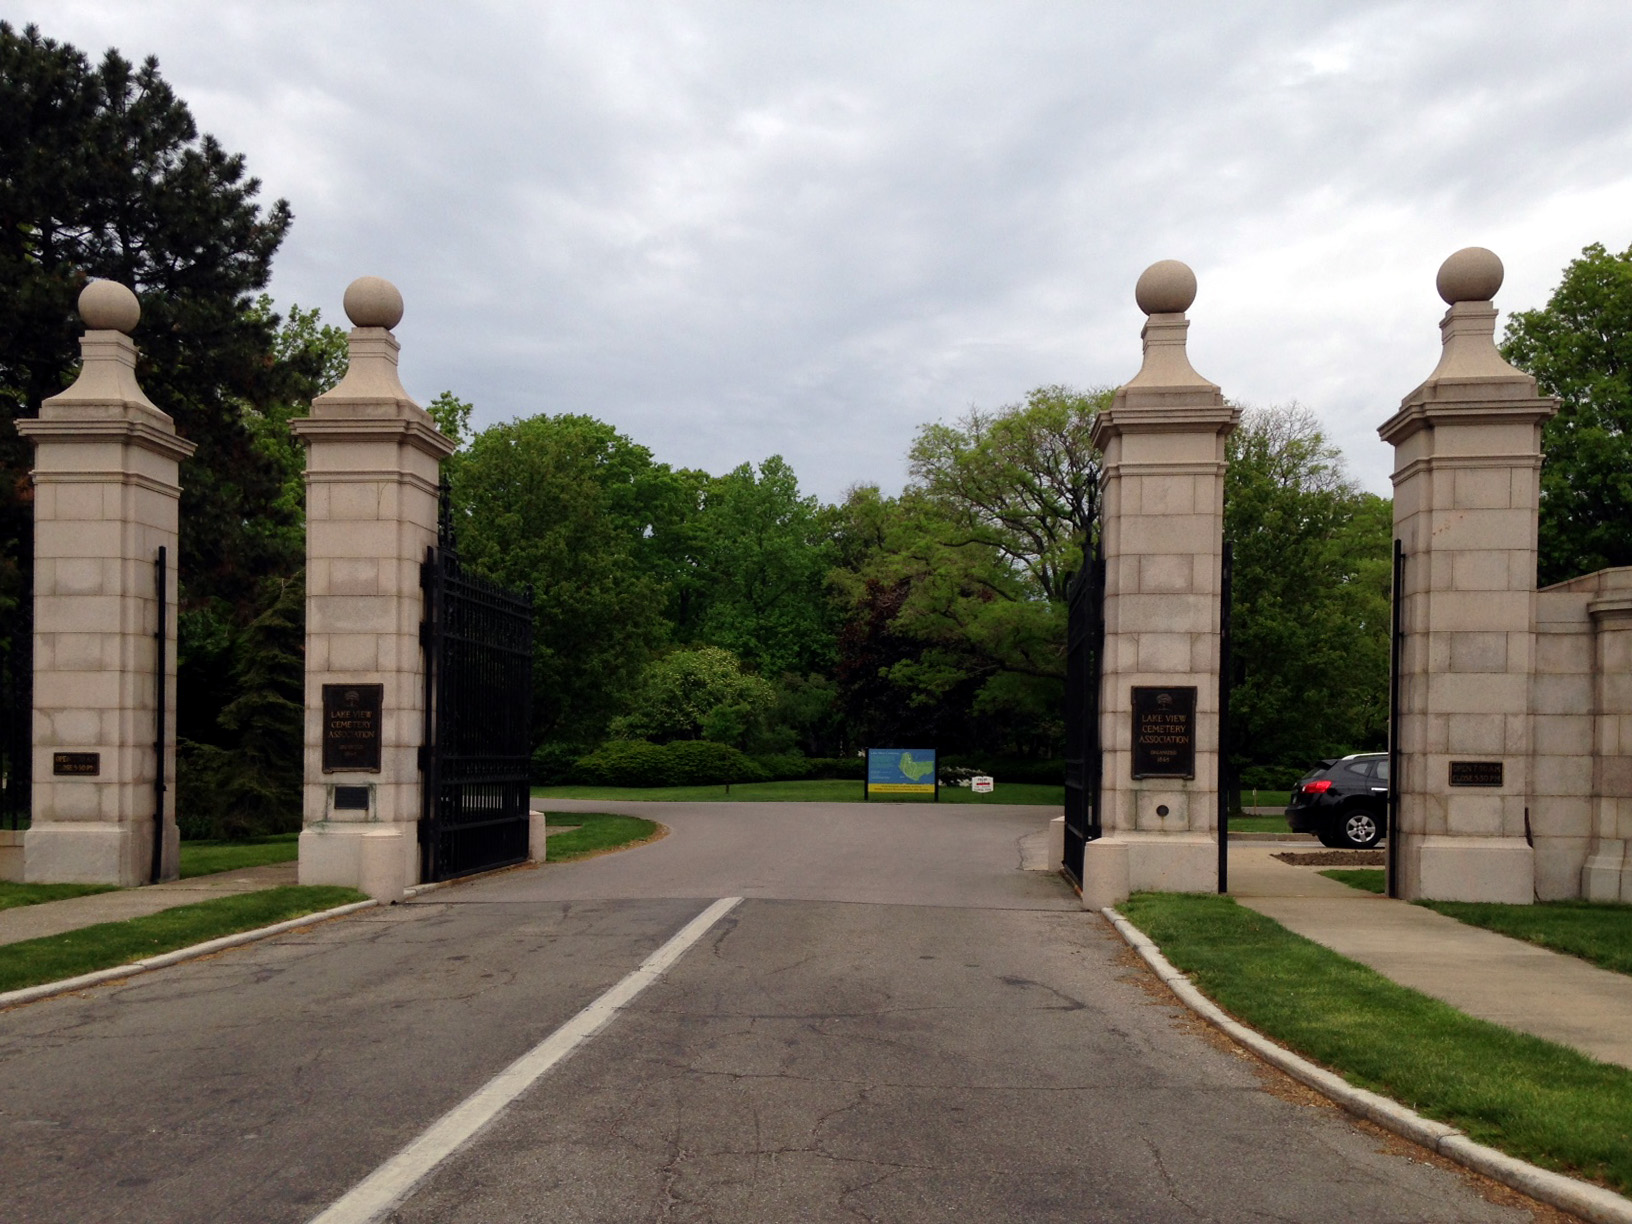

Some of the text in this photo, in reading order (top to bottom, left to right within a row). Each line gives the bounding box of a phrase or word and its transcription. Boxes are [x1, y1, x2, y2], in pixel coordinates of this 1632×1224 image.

[330, 710, 351, 719] LAKE
[1141, 713, 1187, 723] LAKE VIEW
[330, 720, 372, 729] CEMETERY
[1141, 724, 1186, 733] CEMETERY
[1138, 735, 1190, 744] ASSOCIATION
